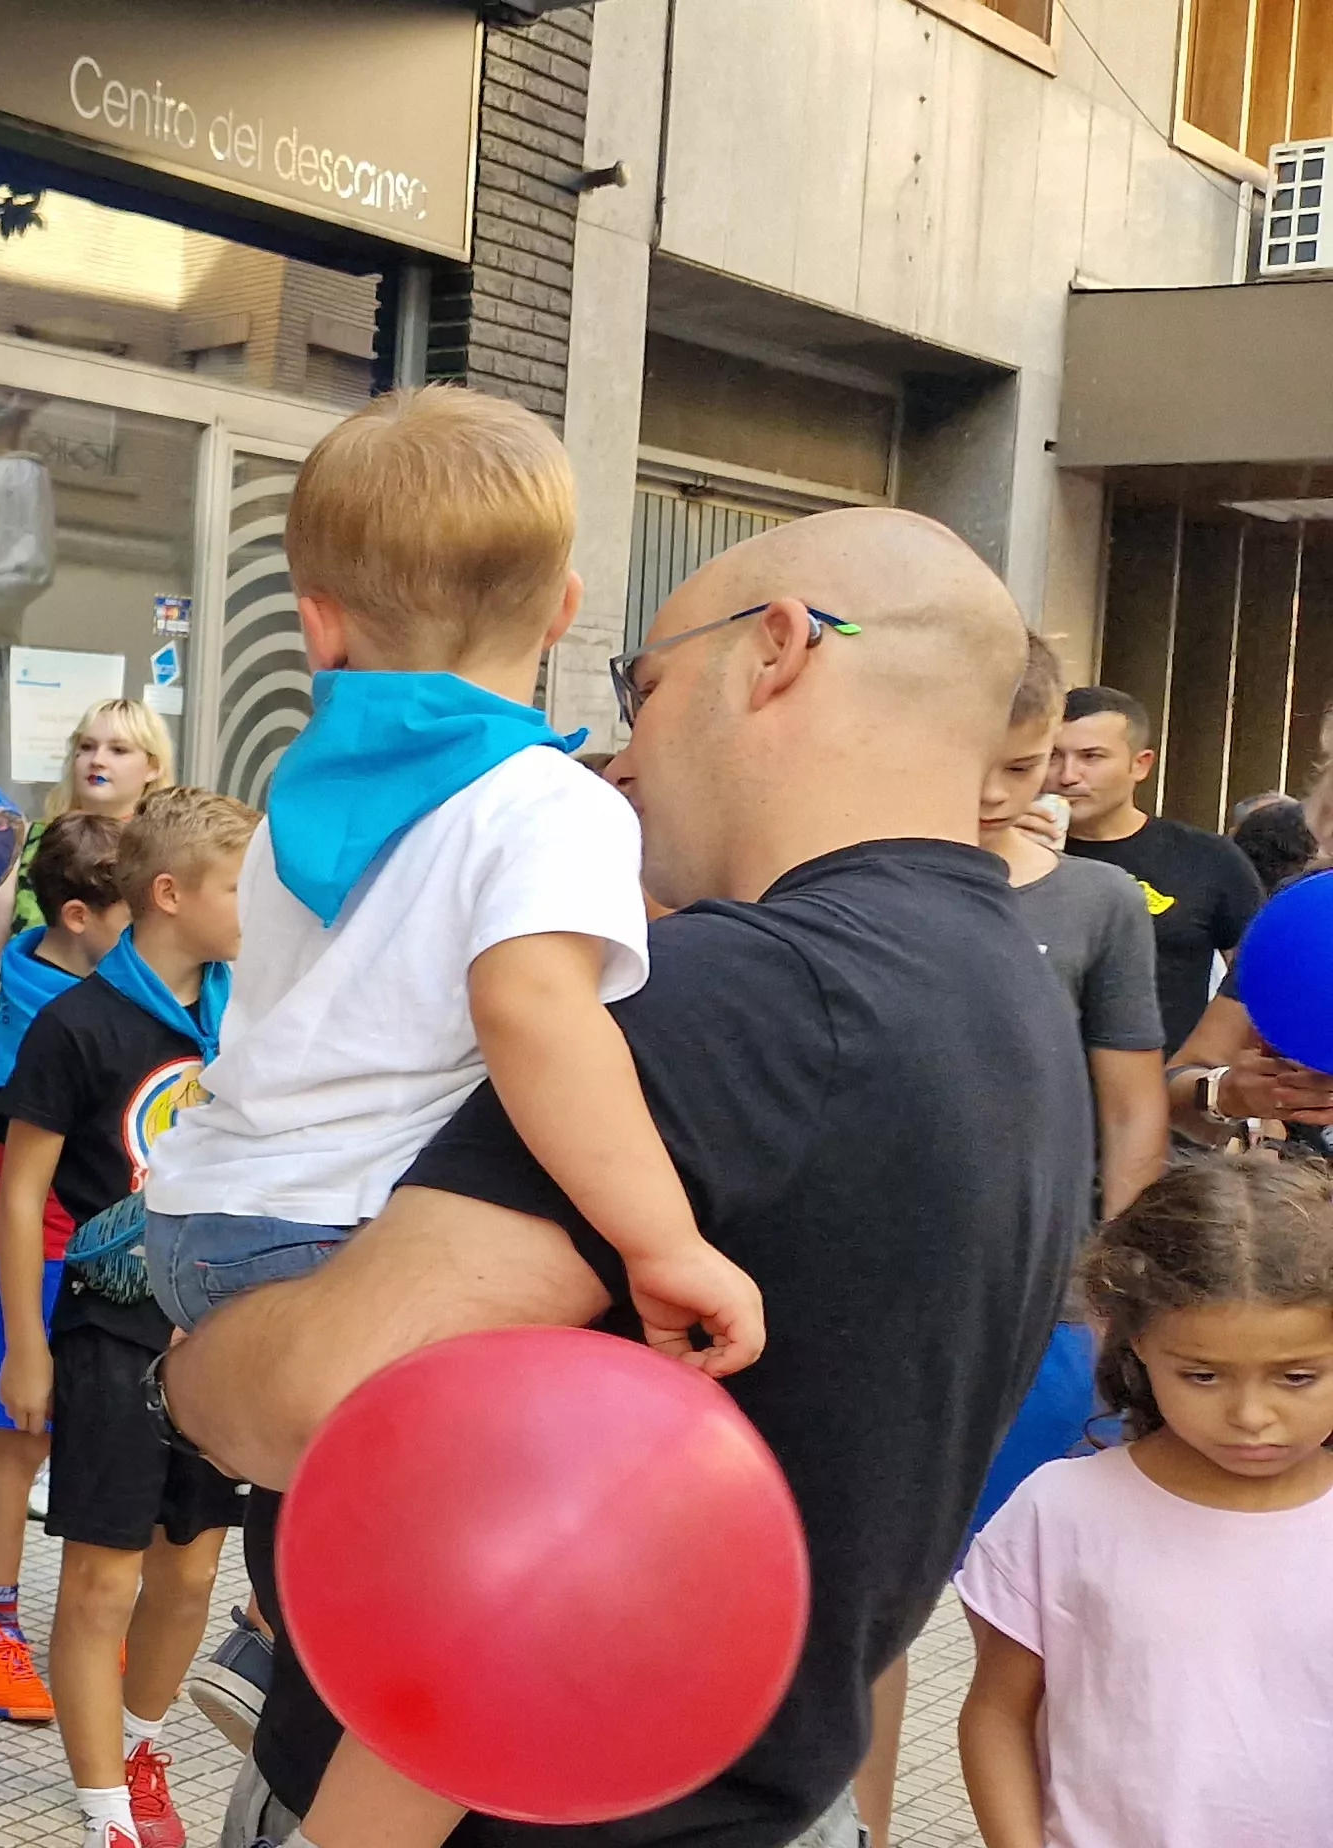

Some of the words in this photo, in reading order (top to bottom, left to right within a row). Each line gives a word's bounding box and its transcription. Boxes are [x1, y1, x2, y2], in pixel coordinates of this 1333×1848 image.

[70, 56, 197, 149] Centro
[209, 109, 263, 171] del
[274, 126, 428, 220] descanso
